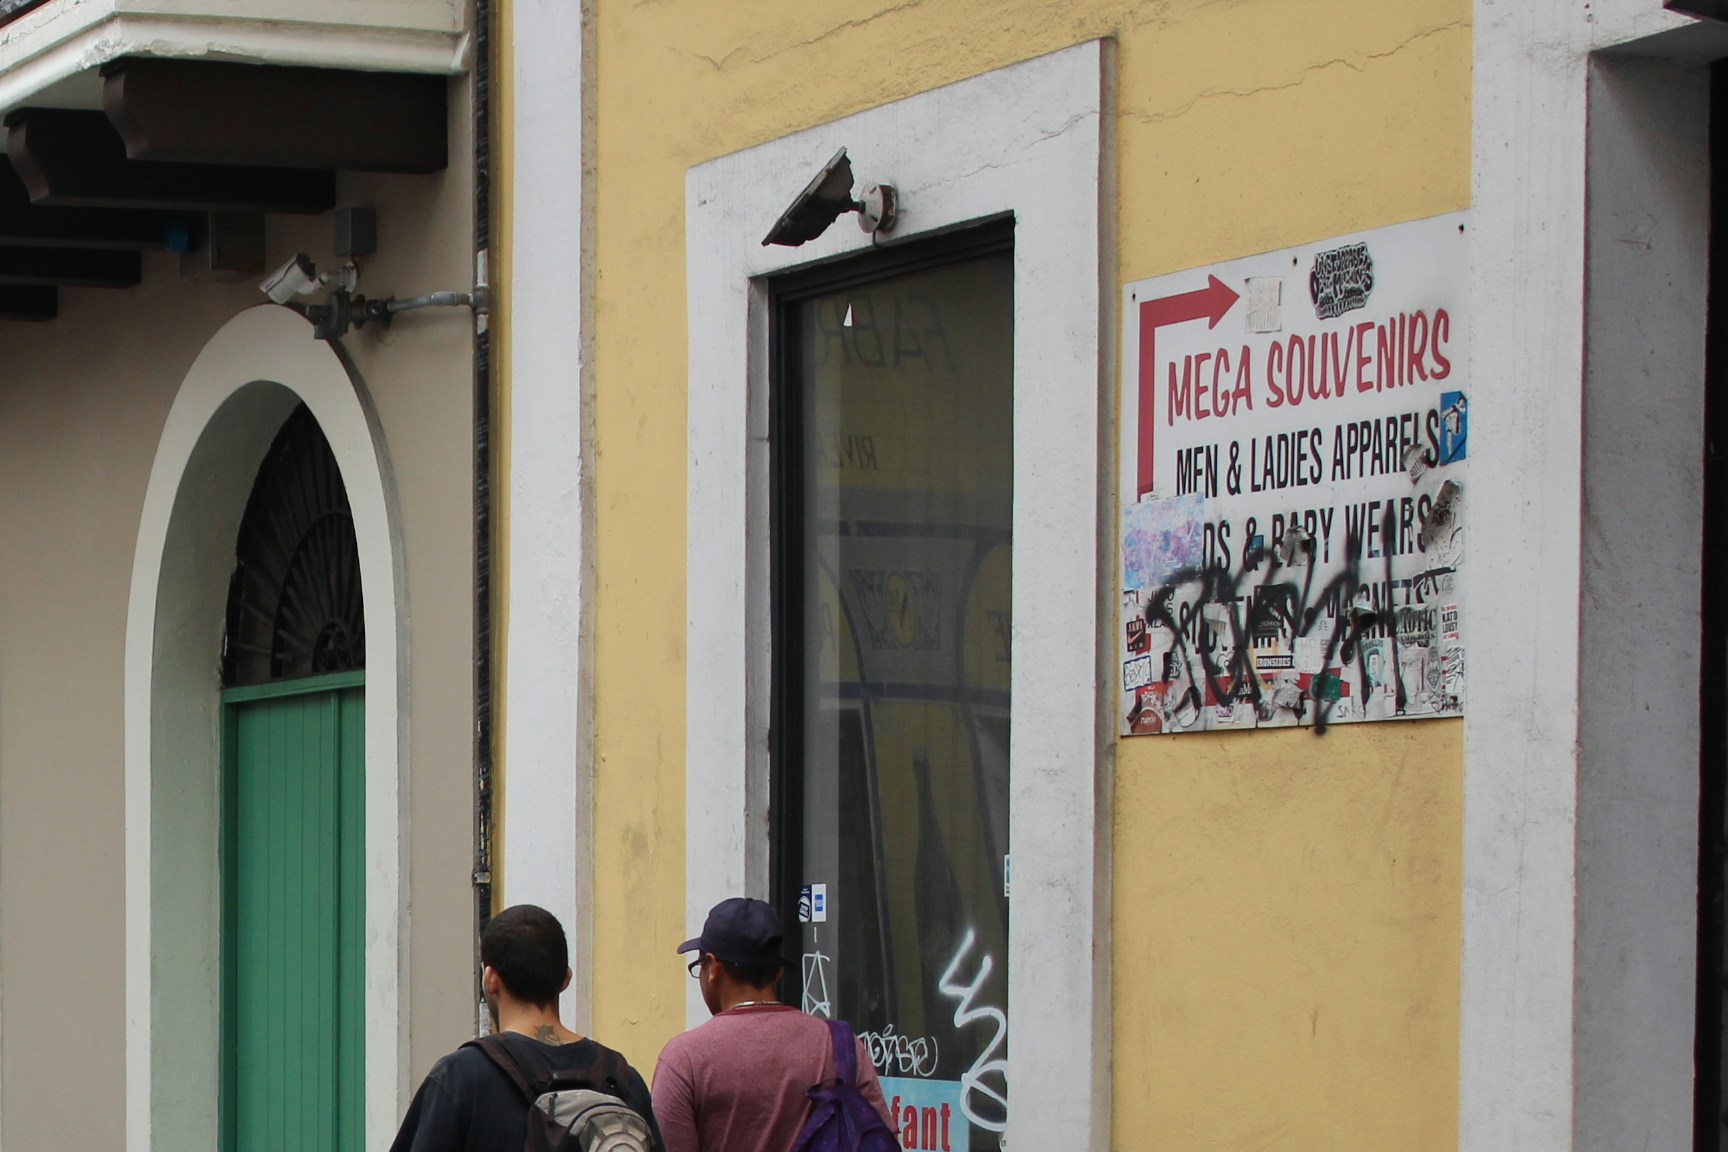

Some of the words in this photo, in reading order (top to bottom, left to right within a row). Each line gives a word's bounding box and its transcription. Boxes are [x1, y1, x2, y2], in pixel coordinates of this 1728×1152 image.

[1168, 345, 1252, 426] MEGA
[1266, 309, 1451, 408] SOUVENIRS
[1177, 444, 1218, 499] MEN
[1225, 441, 1241, 496] &
[1251, 427, 1322, 493] LADIES
[1332, 409, 1440, 481] APPARELS
[1242, 516, 1260, 573] &
[1256, 657, 1291, 668] IRONSIDES
[891, 1096, 951, 1152] fant
